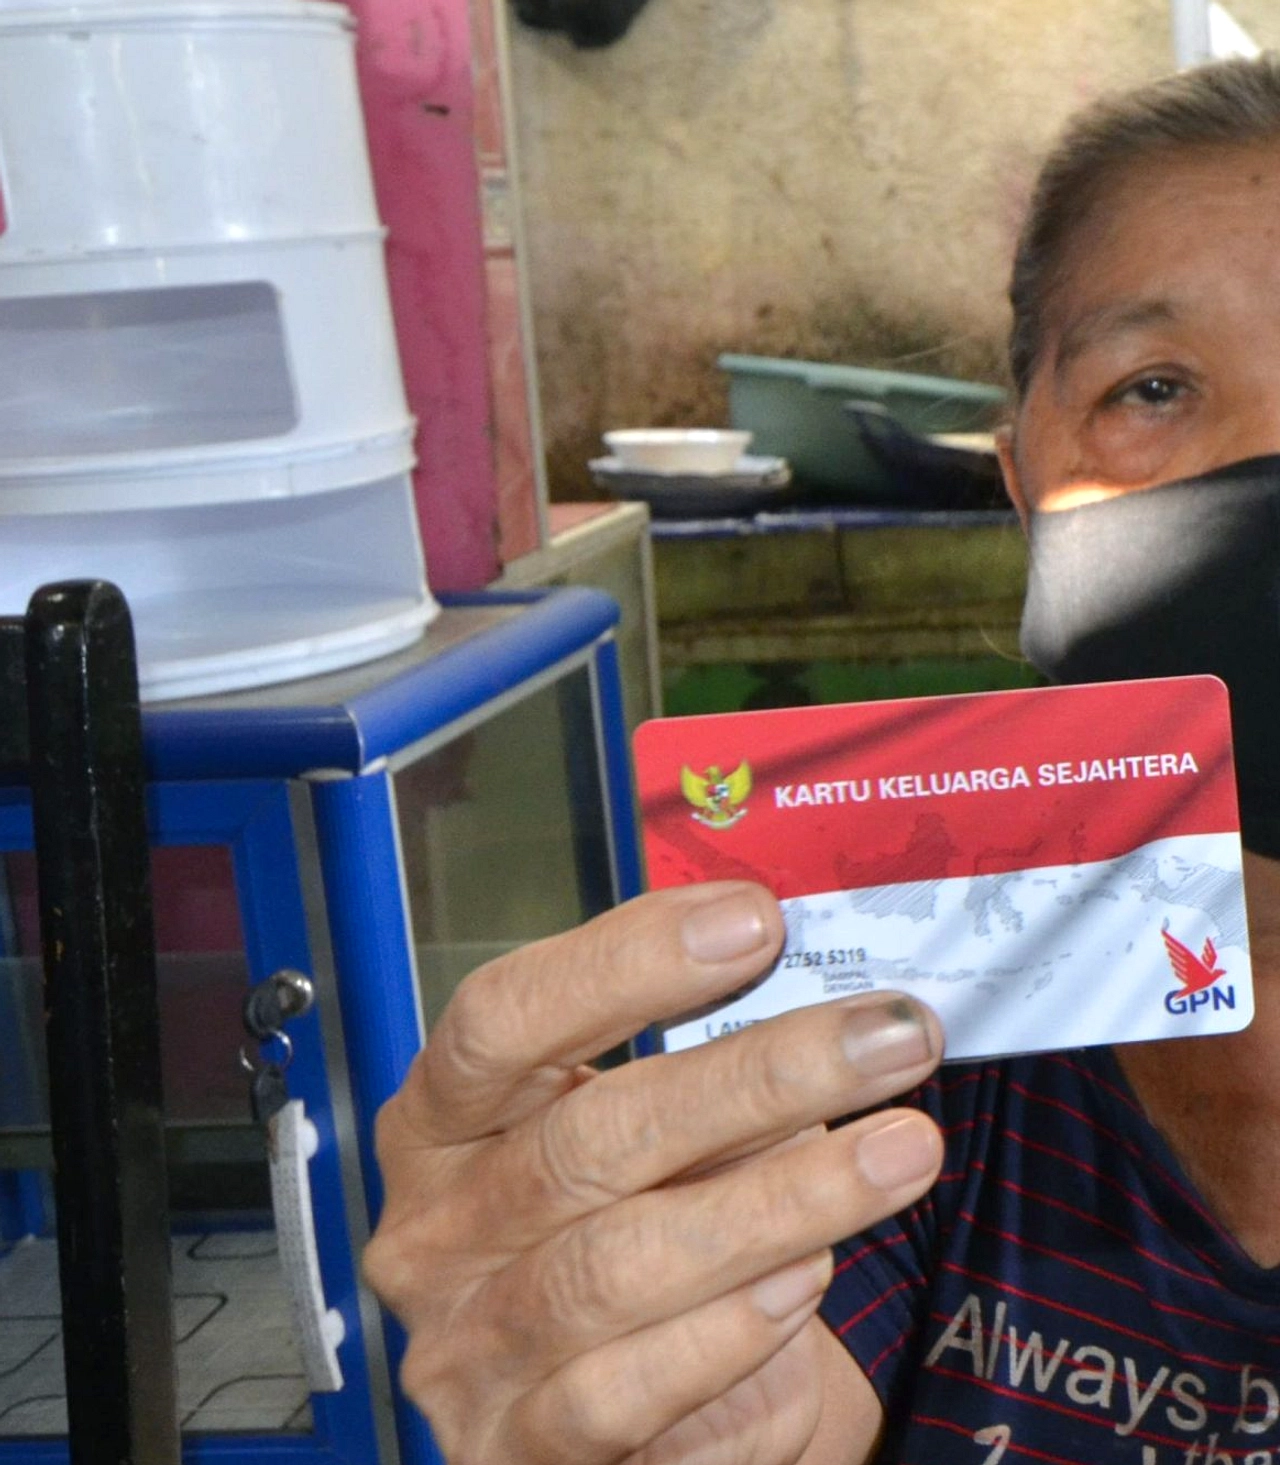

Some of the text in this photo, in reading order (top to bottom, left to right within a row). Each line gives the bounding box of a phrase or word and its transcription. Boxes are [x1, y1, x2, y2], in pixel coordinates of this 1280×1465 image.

[774, 752, 1199, 808] KARTU KELUARGA SEJAHTERA
[784, 951, 822, 969] 2752
[1164, 985, 1235, 1015] GPN
[924, 1293, 1208, 1435] Always
